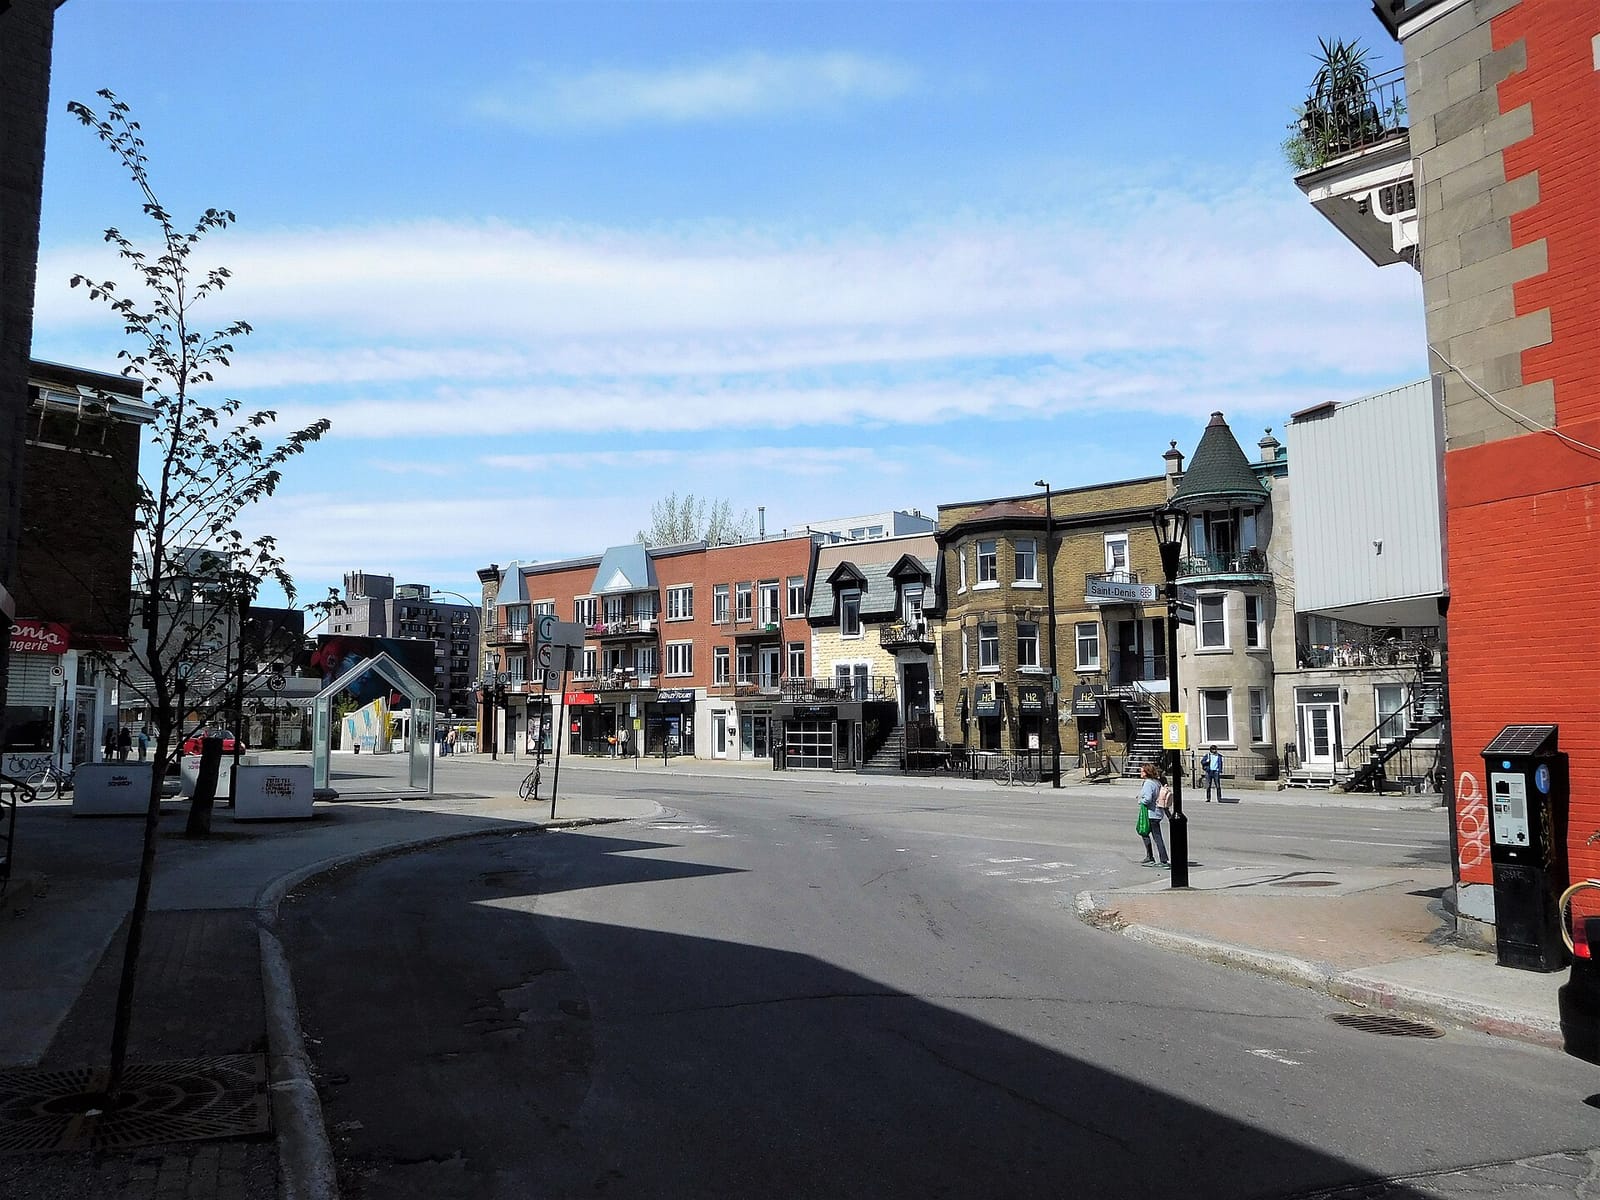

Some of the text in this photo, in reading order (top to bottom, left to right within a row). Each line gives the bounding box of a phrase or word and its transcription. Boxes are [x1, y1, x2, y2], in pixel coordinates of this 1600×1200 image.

[1091, 585, 1136, 598] Saint-Denis
[1025, 692, 1038, 702] H2
[1081, 692, 1094, 702] H2
